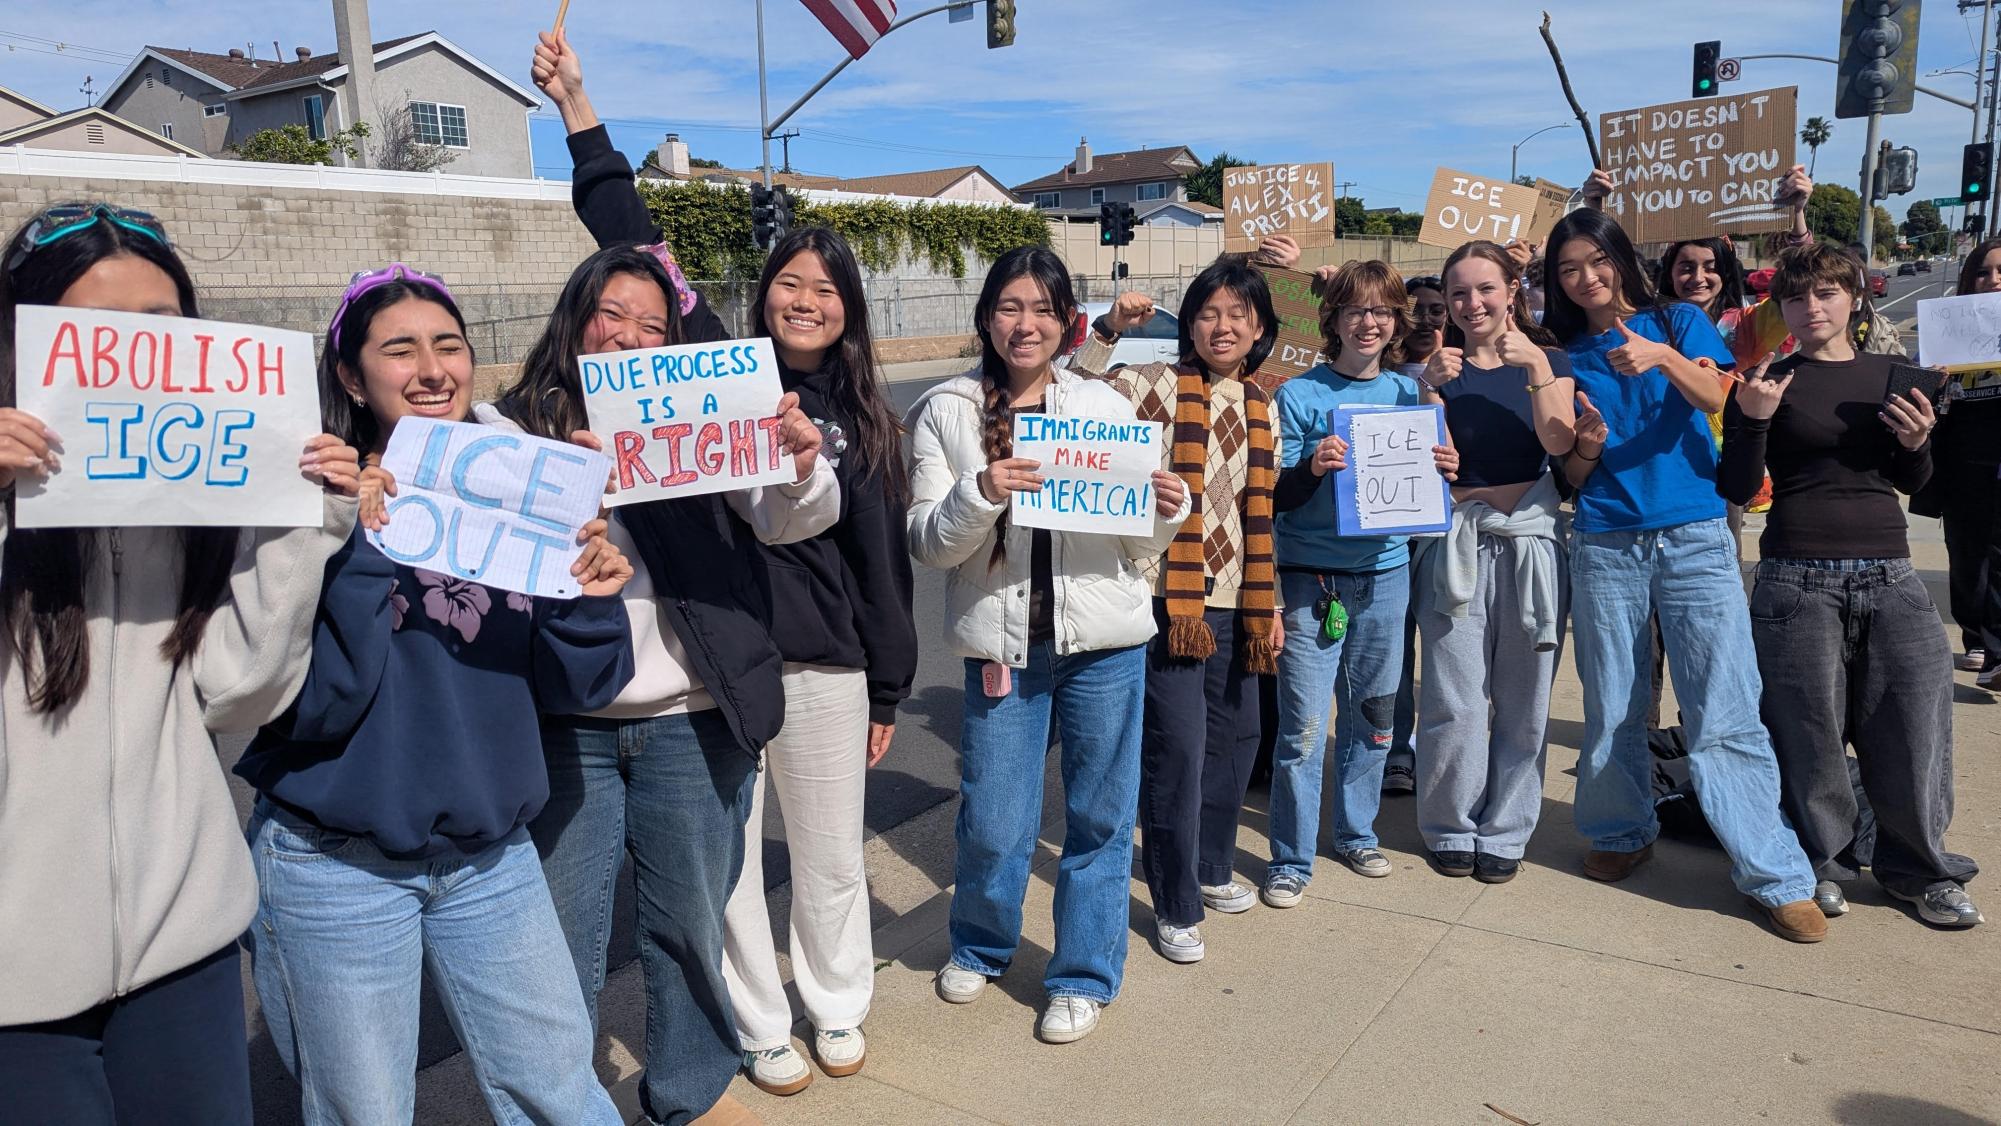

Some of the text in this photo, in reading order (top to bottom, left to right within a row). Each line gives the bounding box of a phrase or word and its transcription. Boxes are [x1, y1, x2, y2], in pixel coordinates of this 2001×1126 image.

[1607, 96, 1770, 138] IT DOESN'T
[1607, 132, 1725, 166] HAVE TO
[1226, 164, 1321, 191] JUSTICE 4
[1606, 148, 1780, 188] IMPACT YOU
[1230, 184, 1294, 216] ALEX
[1451, 177, 1504, 208] ICE
[1607, 191, 1625, 215] 4
[1631, 187, 1684, 213] YOU
[1688, 189, 1713, 204] TO
[1241, 192, 1329, 241] PRETTI
[1438, 205, 1521, 243] OUT!
[42, 321, 286, 396] ABOLISH
[584, 345, 759, 395] DUE PROCESS
[1281, 345, 1332, 368] DIE
[637, 393, 719, 424] IS A
[85, 402, 256, 487] ICE
[1019, 416, 1152, 445] IMMIGRANTS
[1367, 428, 1422, 459] ICE
[614, 415, 785, 490] RIGHT
[1055, 447, 1112, 471] MAKE
[412, 423, 587, 535] ICE
[1366, 476, 1422, 505] OUT
[374, 494, 570, 594] OUT
